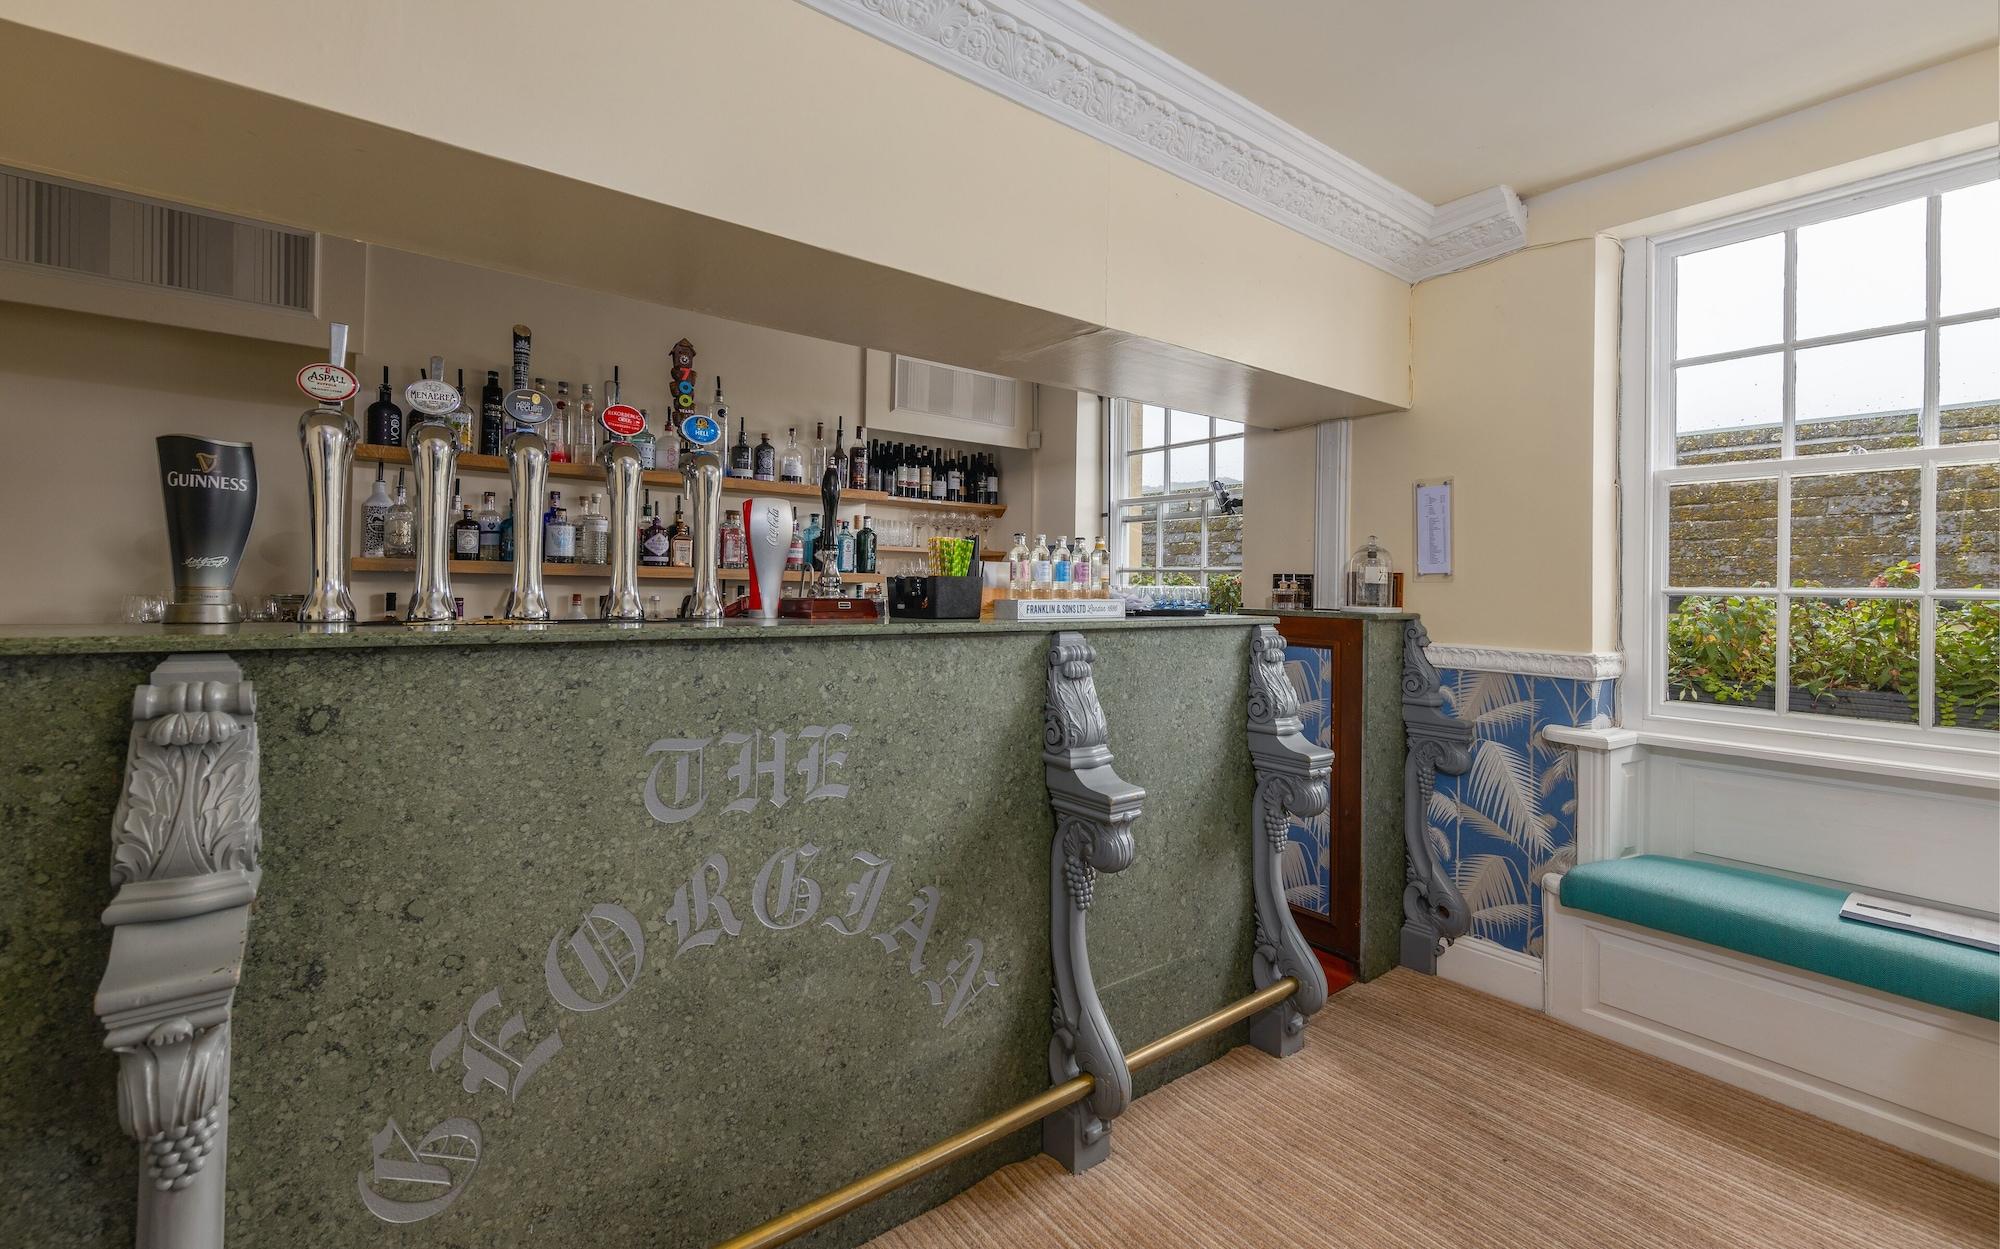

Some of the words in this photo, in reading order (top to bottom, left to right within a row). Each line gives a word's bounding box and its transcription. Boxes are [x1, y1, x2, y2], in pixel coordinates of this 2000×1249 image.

[307, 371, 346, 384] ASPALL
[410, 390, 455, 401] MENABREA
[167, 471, 249, 491] GUINNESS
[1026, 604, 1055, 614] FRANKLIN
[1056, 604, 1061, 614] &
[1062, 604, 1076, 614] SONS
[1076, 604, 1087, 614] LTD
[643, 723, 852, 824] THE
[357, 842, 1000, 1223] GEORGIAN
